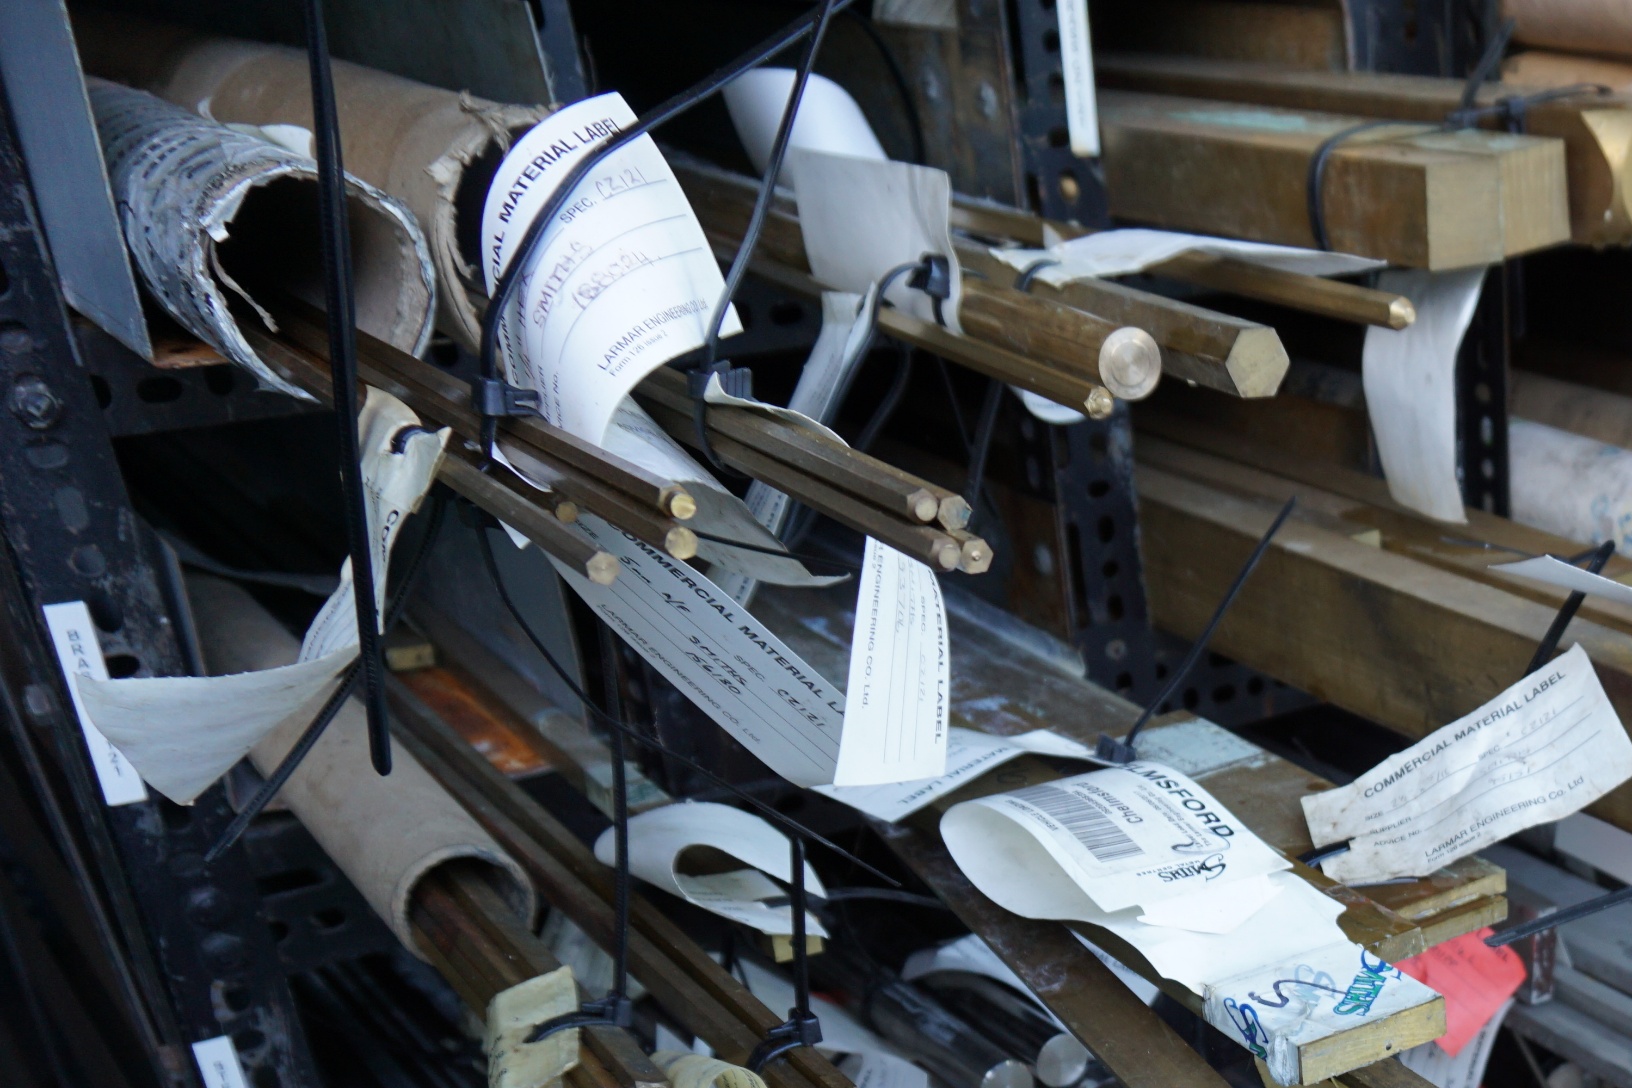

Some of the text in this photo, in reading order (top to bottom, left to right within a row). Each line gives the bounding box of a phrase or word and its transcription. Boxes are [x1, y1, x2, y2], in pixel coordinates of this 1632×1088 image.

[498, 139, 578, 224] MATERIAL
[560, 197, 597, 225] SPEC.
[597, 326, 646, 371] LARMAR
[609, 359, 629, 378] Form
[864, 553, 885, 653] ENGINEERING
[919, 595, 927, 637] SPEC.
[598, 603, 648, 648] LARMAR
[648, 646, 723, 712] ENGINEERING
[738, 625, 823, 699] MATERIAL
[863, 655, 874, 681] CO.
[927, 569, 945, 746] MATERIAL LABEL
[1363, 741, 1452, 799] COMMERCIAL
[1454, 700, 1523, 741] MATERIAL
[1524, 670, 1567, 703] LABEL
[1075, 781, 1144, 825] Chelmsford
[1364, 810, 1384, 822] SIZE
[1424, 776, 1586, 858] LARMAR ENGINEERING Co. Ltd
[1369, 817, 1413, 835] SUPPLIER
[1373, 833, 1406, 847] ADVICE
